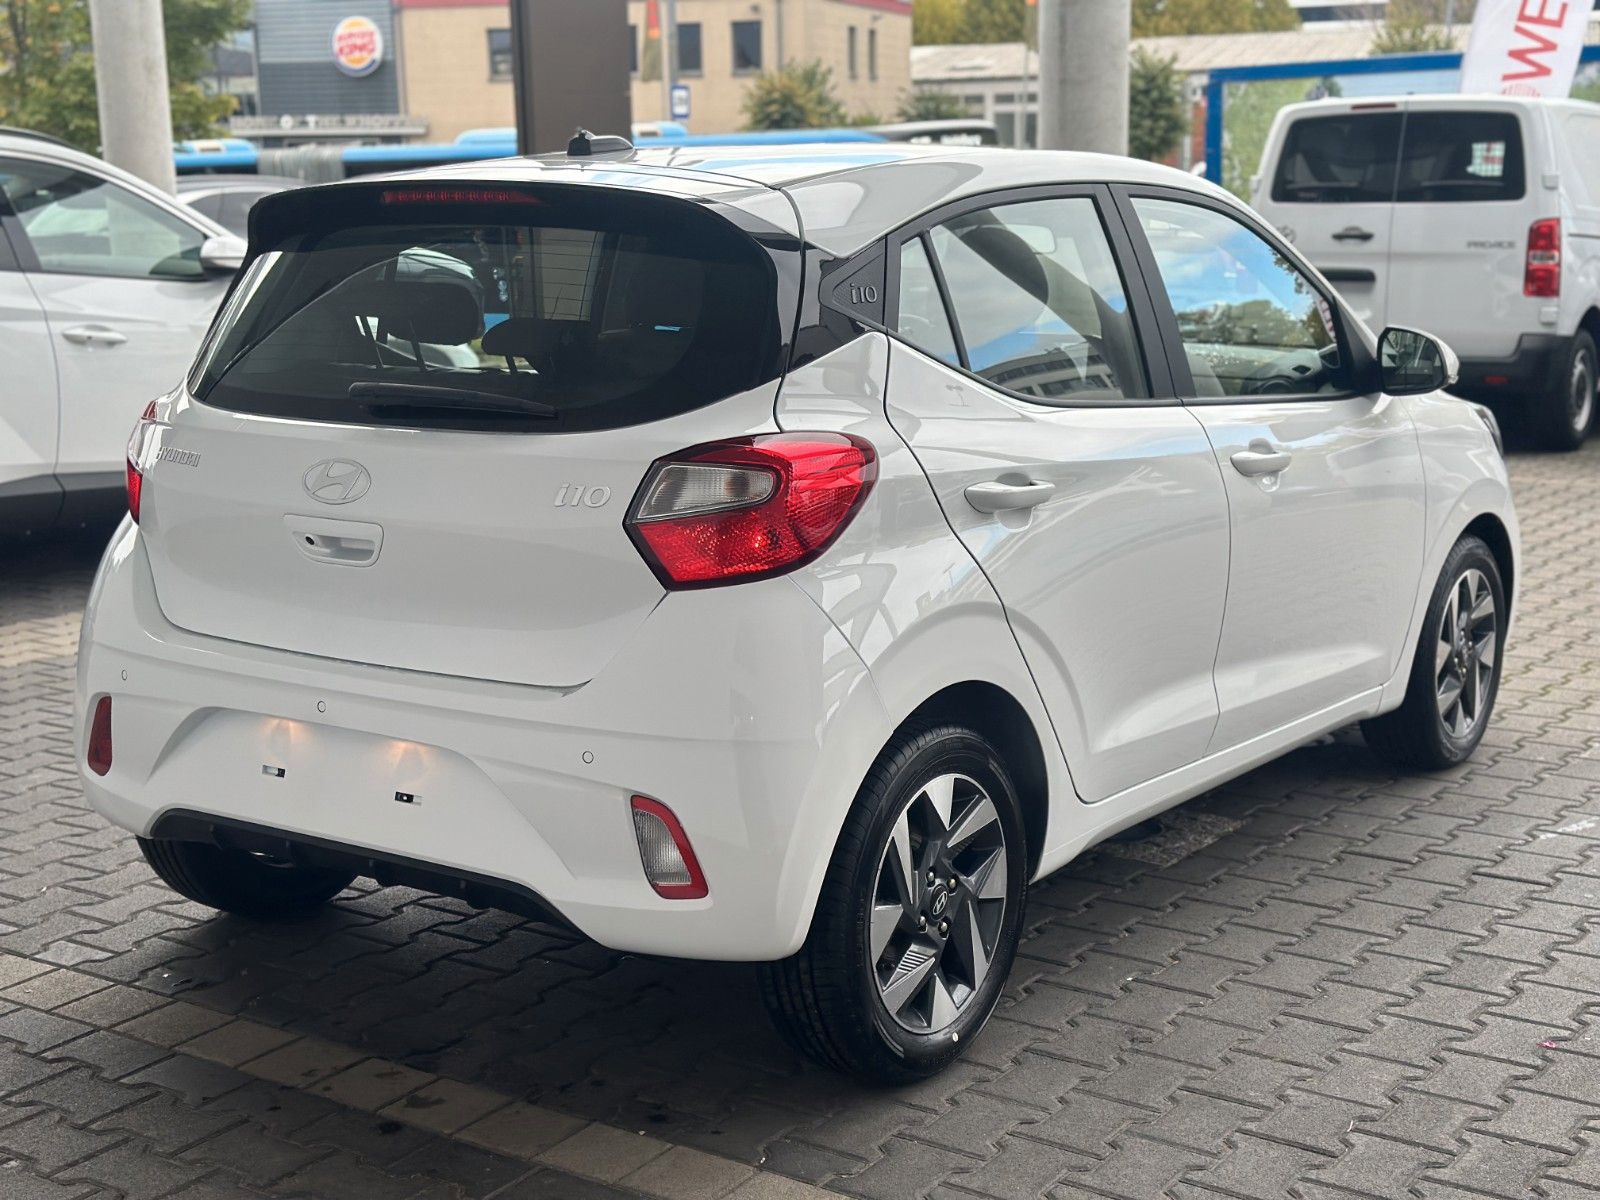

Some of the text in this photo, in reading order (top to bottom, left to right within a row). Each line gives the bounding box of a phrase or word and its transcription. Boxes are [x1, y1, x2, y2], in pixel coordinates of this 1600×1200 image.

[336, 44, 376, 57] KING
[849, 282, 878, 305] i10
[155, 446, 201, 468] HYUNDAI
[553, 482, 611, 509] i10
